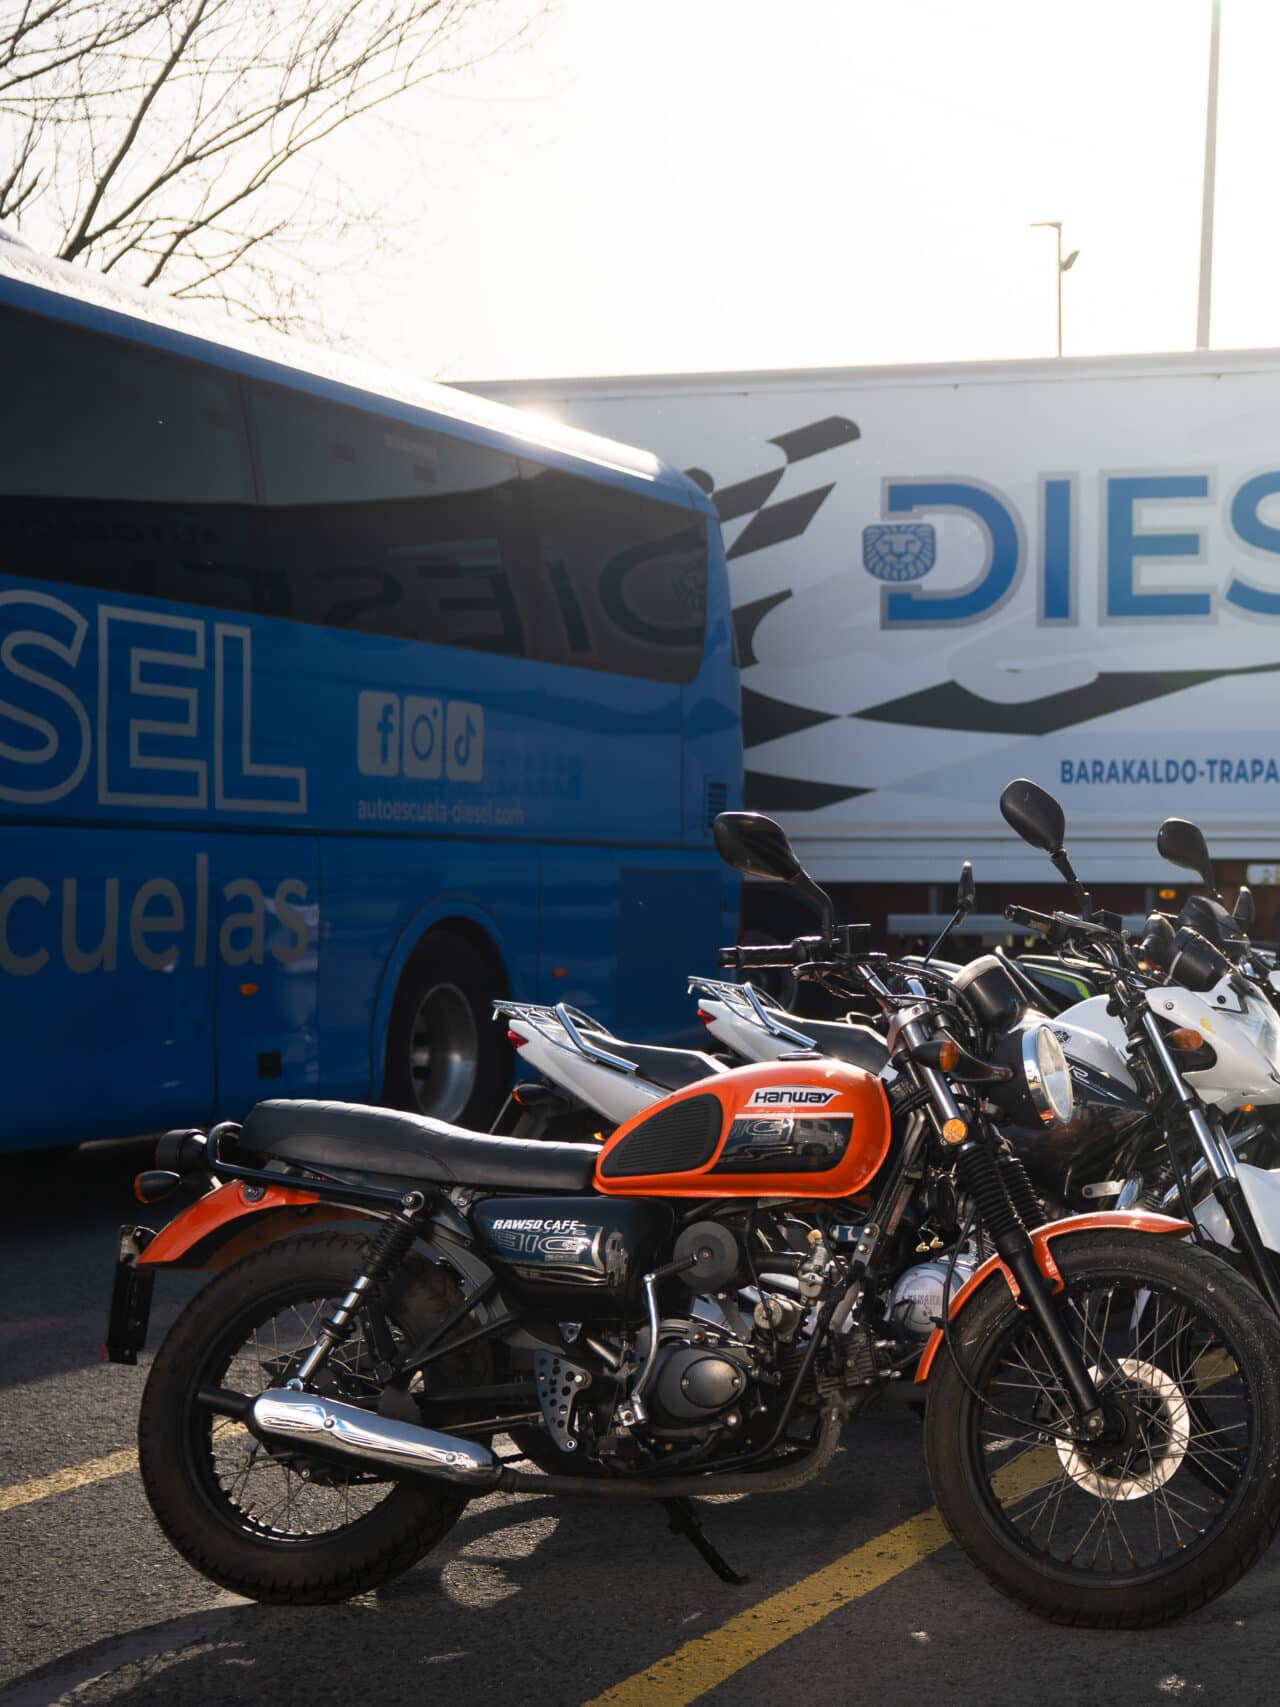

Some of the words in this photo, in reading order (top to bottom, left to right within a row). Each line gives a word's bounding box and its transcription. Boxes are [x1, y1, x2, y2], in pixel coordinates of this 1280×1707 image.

[0, 589, 308, 814] SEL
[357, 797, 525, 825] autoescuela-diesel.com
[0, 853, 310, 976] cuelas
[543, 1219, 580, 1231] CAFE
